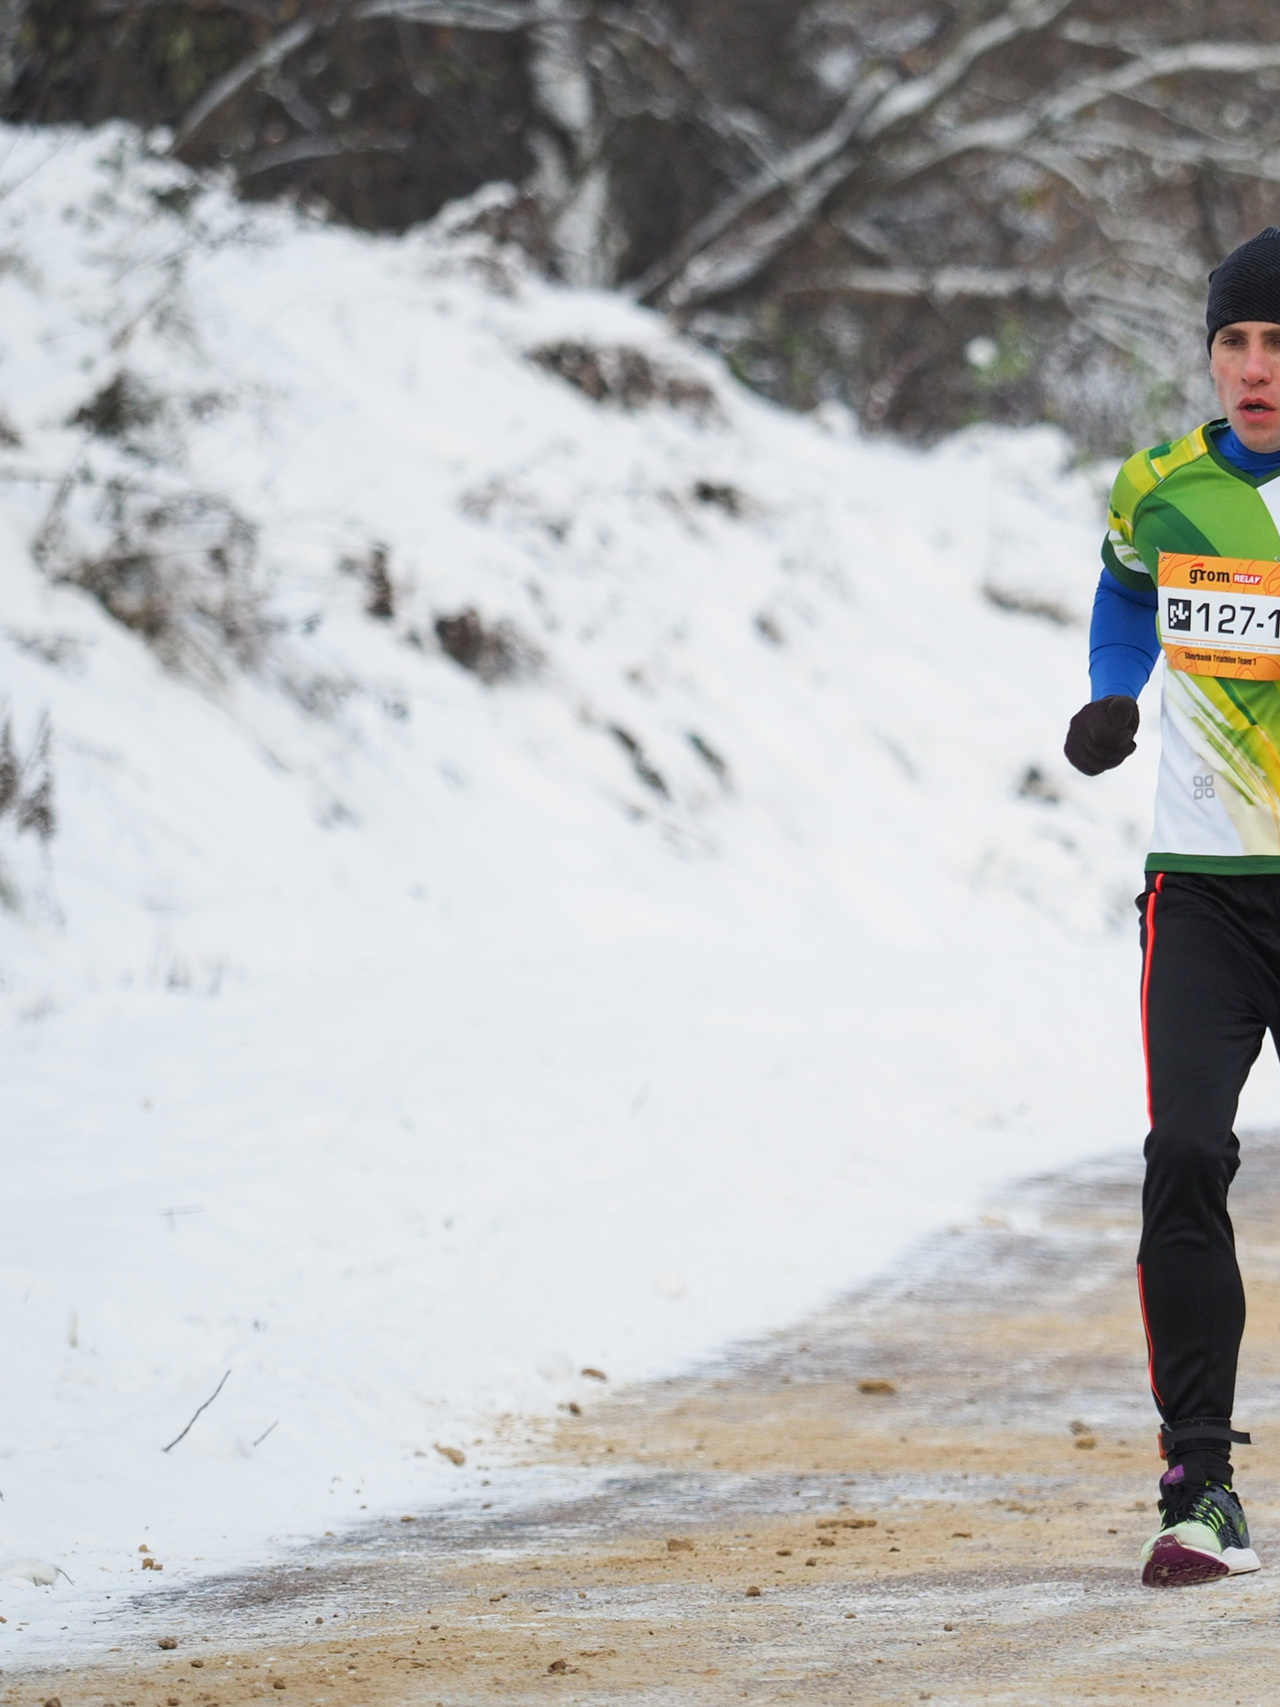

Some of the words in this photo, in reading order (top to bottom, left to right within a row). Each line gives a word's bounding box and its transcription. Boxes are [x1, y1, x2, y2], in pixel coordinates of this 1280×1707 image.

[1189, 566, 1230, 584] grom
[1233, 574, 1261, 585] RELAY
[1196, 603, 1280, 639] 127-1
[1184, 652, 1212, 662] Sberbank
[1213, 655, 1236, 664] Triathlon
[1238, 657, 1252, 665] Team
